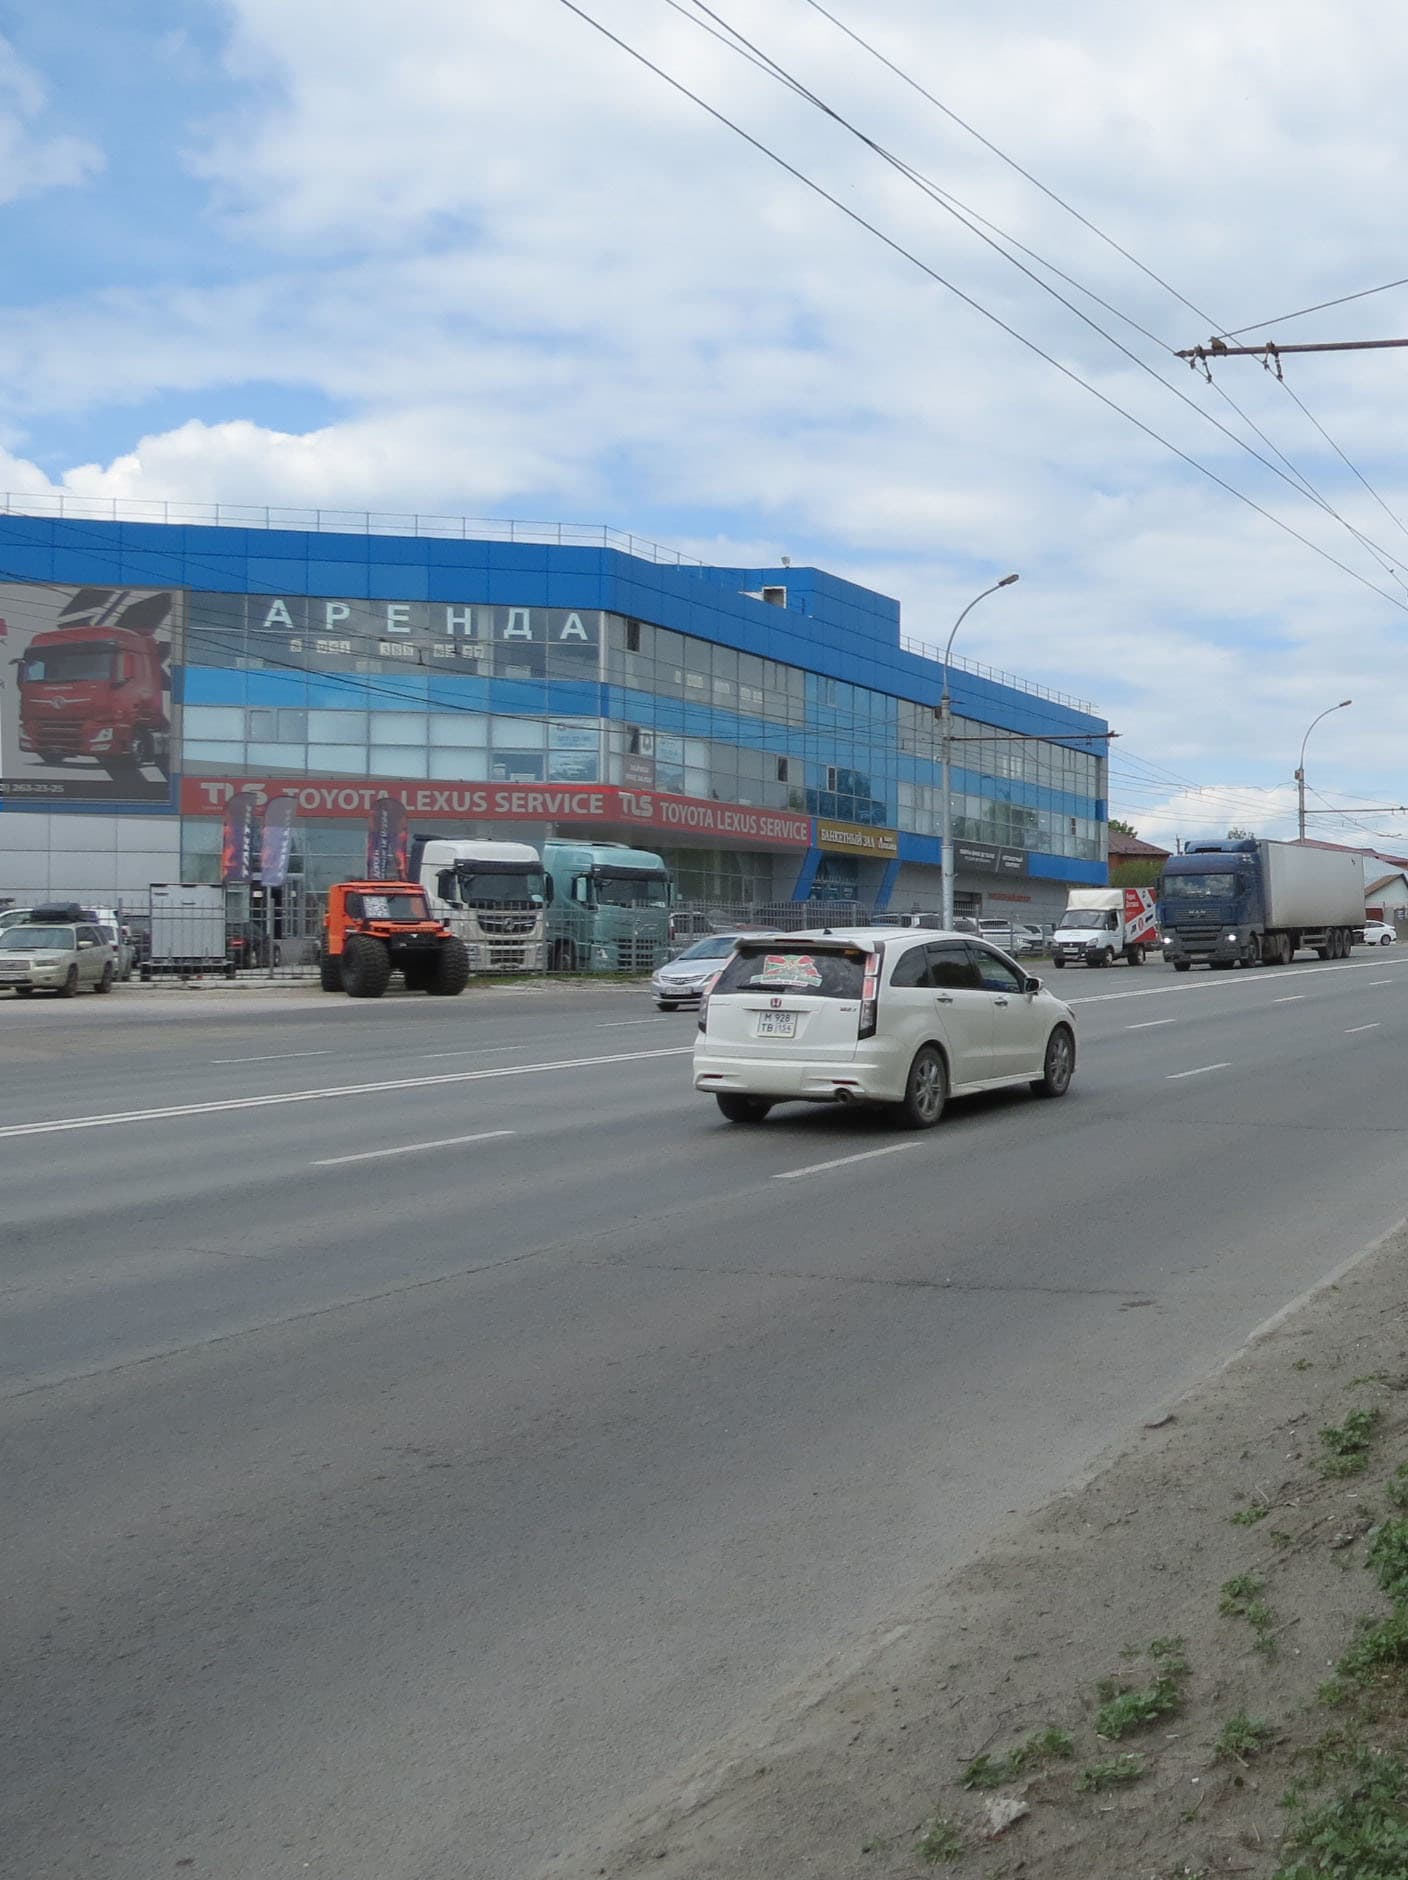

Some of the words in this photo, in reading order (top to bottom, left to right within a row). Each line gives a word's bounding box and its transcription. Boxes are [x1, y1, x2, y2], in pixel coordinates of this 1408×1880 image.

[263, 599, 588, 641] АРЕНДА
[401, 789, 489, 812] LEXUS
[494, 791, 604, 815] SERVICE
[618, 791, 654, 818] TLS
[660, 801, 714, 828] TOYOTA
[717, 811, 758, 834] LEXUS
[759, 816, 808, 842] SERVICE
